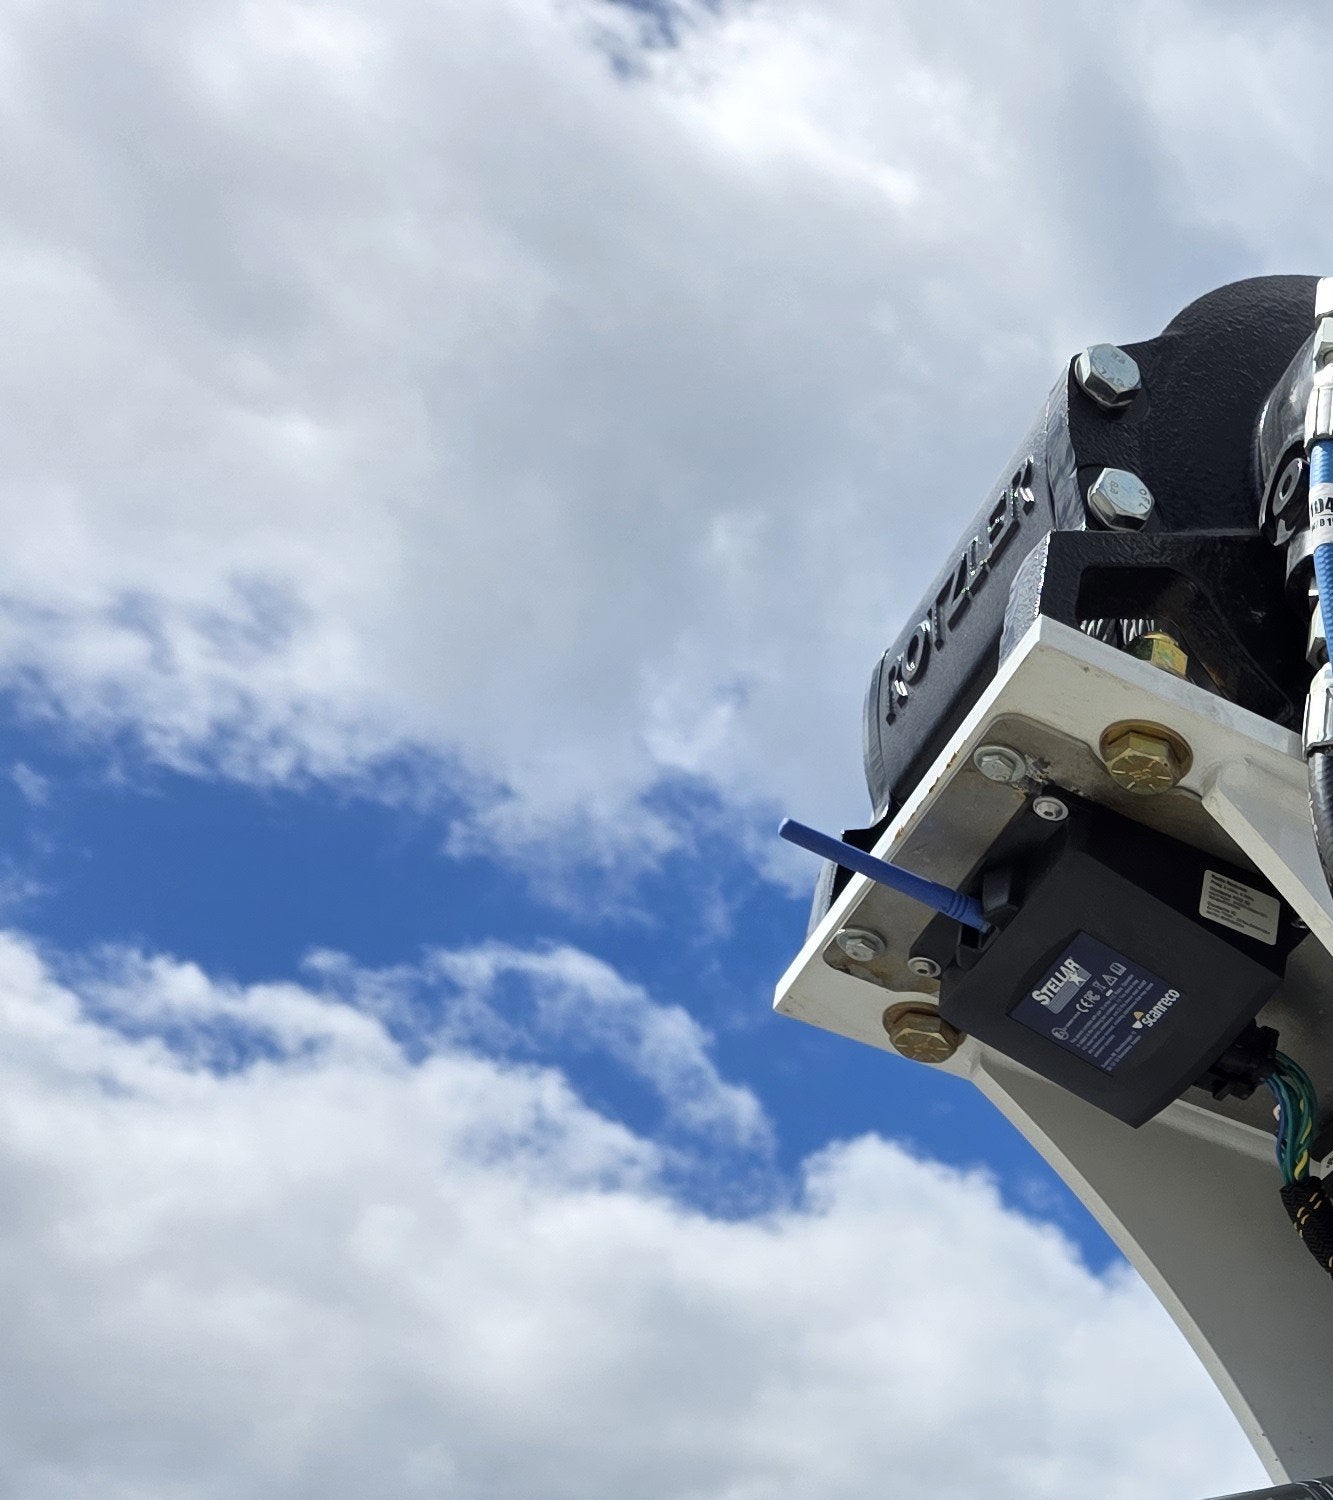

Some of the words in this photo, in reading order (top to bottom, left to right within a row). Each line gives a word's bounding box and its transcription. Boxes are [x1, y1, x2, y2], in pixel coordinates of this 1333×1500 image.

[886, 455, 1035, 726] ROTZLER
[1032, 958, 1081, 1006] STELLAR
[1142, 989, 1181, 1028] scanreco
